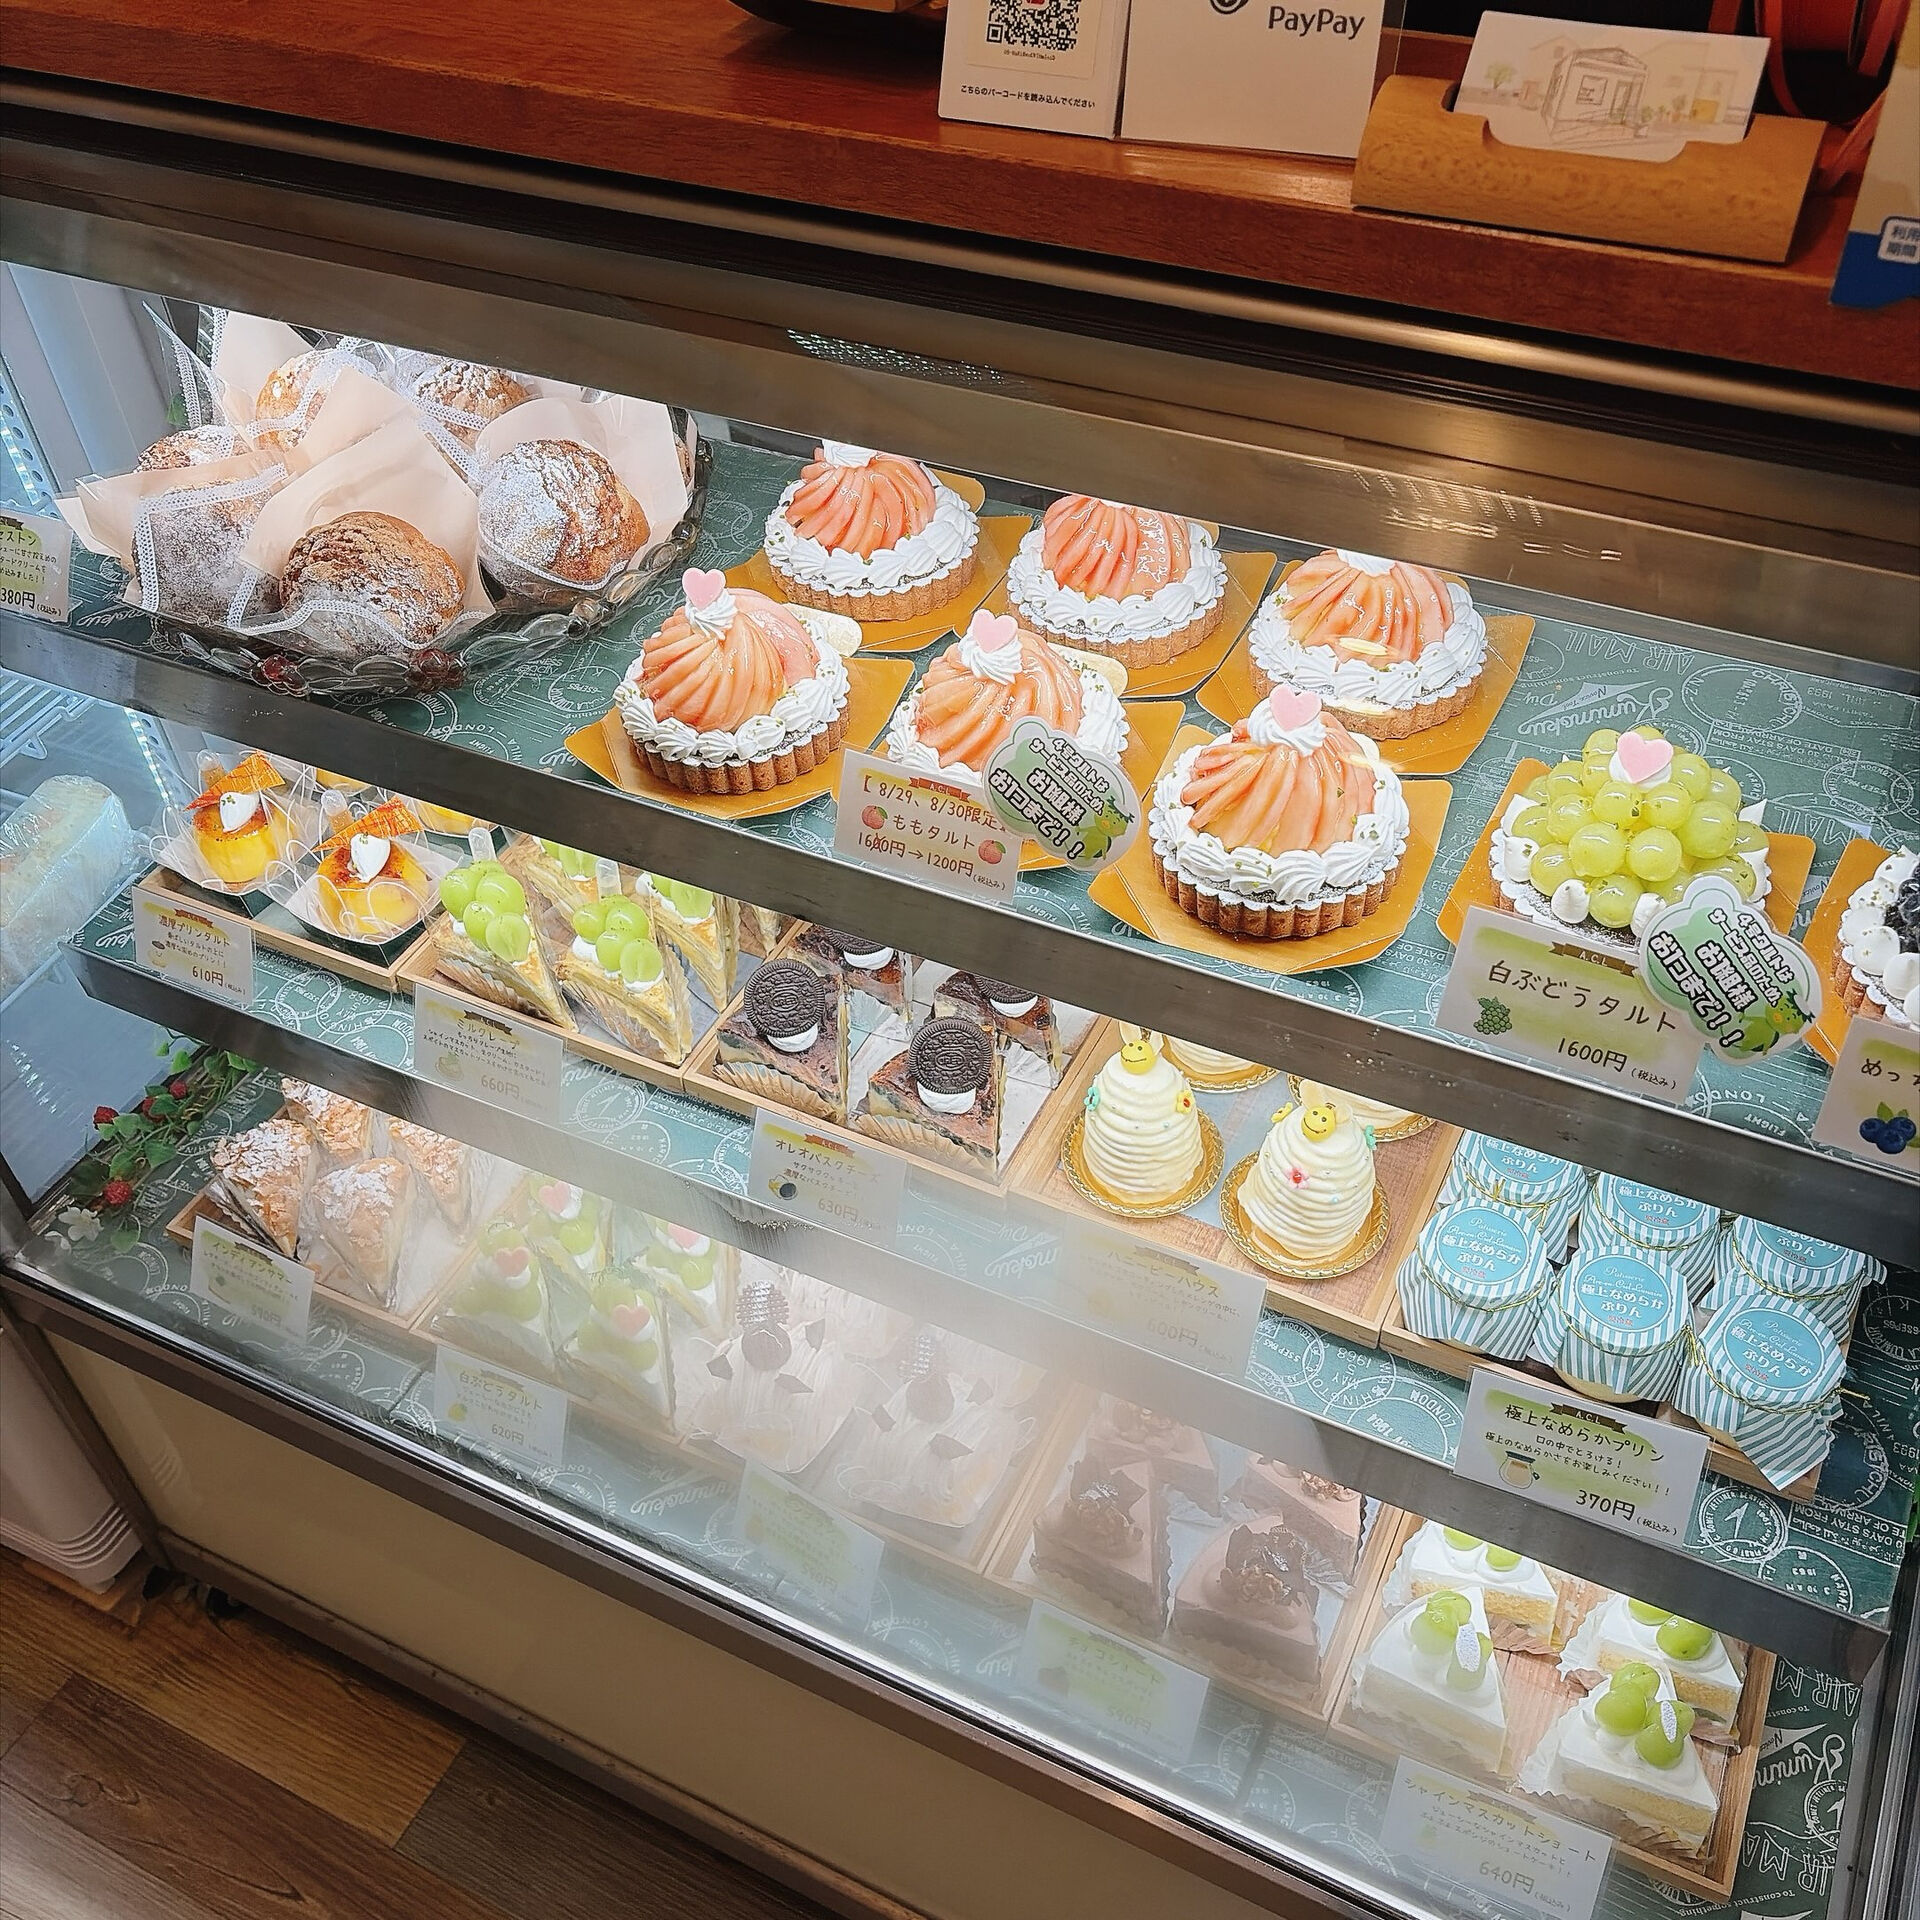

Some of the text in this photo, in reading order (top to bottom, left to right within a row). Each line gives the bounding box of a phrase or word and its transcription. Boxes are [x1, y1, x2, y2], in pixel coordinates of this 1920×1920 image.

[1267, 6, 1366, 41] PayPay
[960, 84, 1096, 109] こちらのバーコードを読み込んでください
[1517, 686, 1674, 737] Kumimoku
[891, 812, 977, 850] ももタルト
[192, 965, 224, 987] 610円
[1486, 960, 1678, 1035] 白ぶどうタルト
[457, 1018, 521, 1050] ミルクレープ
[1557, 1037, 1629, 1073] 1600円
[480, 1074, 521, 1100] 660円
[817, 1197, 859, 1223] 630円
[1504, 1403, 1666, 1463] 極上なめらかプリン
[1536, 1434, 1624, 1469] 口の中でとろける！
[1575, 1488, 1636, 1522] 370円
[1793, 1503, 1829, 1524] FROM
[1830, 1517, 1861, 1536] STAY
[1862, 1527, 1894, 1547] DAYS
[1403, 1776, 1597, 1862] シャインマスカットショート
[1478, 1860, 1536, 1896] 640円
